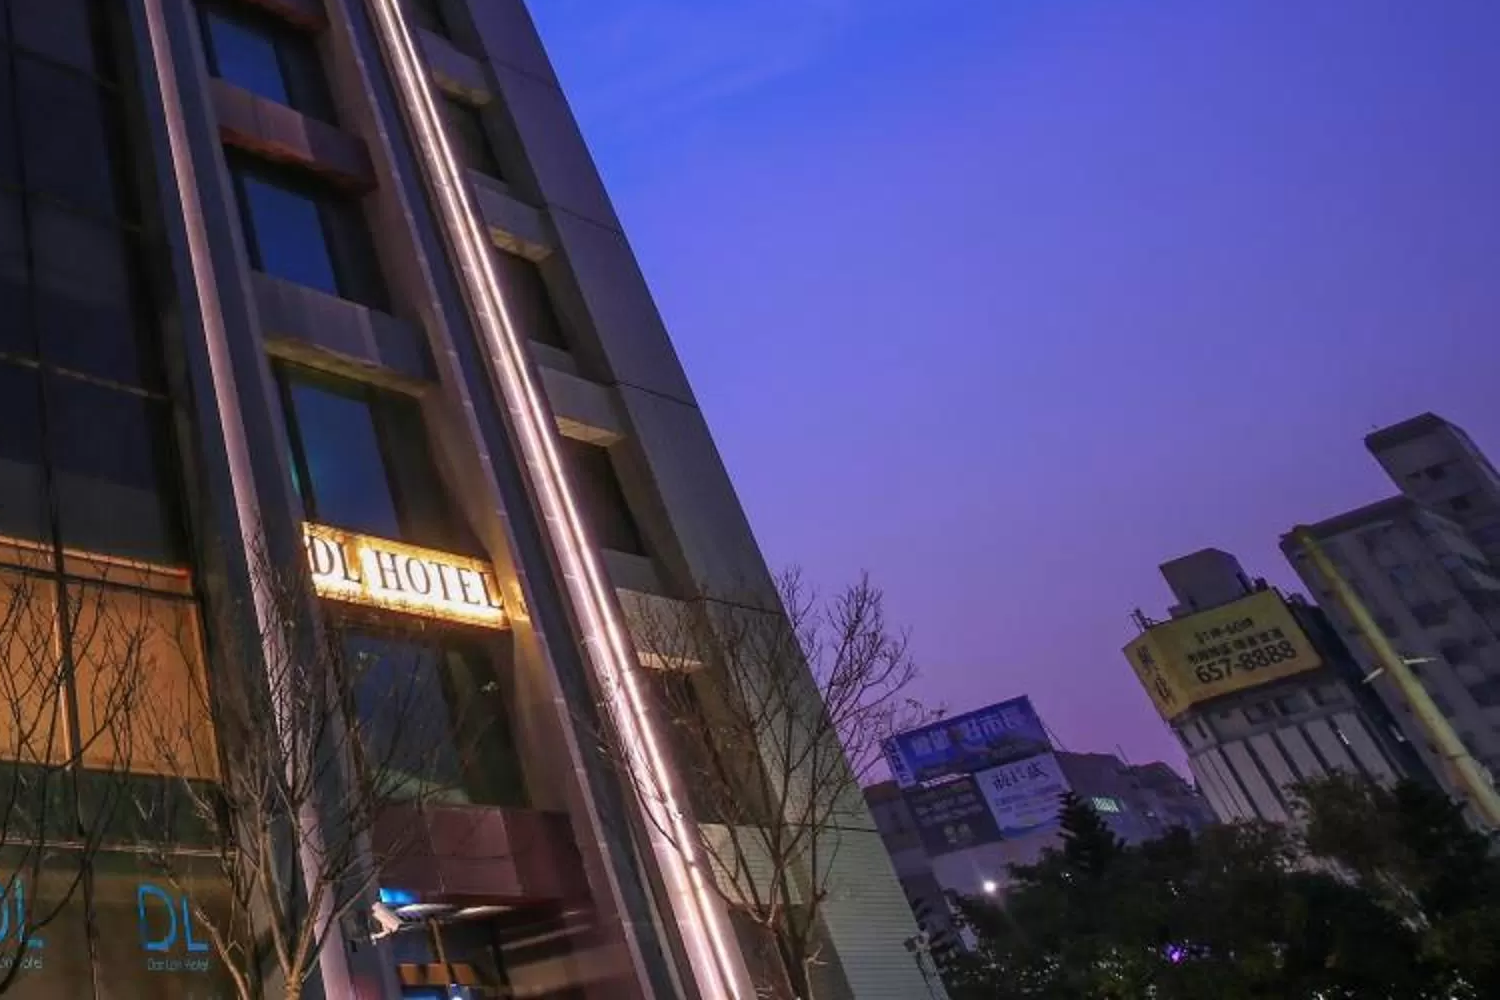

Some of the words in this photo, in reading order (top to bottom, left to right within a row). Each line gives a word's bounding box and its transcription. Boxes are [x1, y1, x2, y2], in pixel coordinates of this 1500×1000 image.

[308, 536, 362, 584] DL
[374, 550, 505, 610] HOTEL
[137, 882, 210, 952] DL
